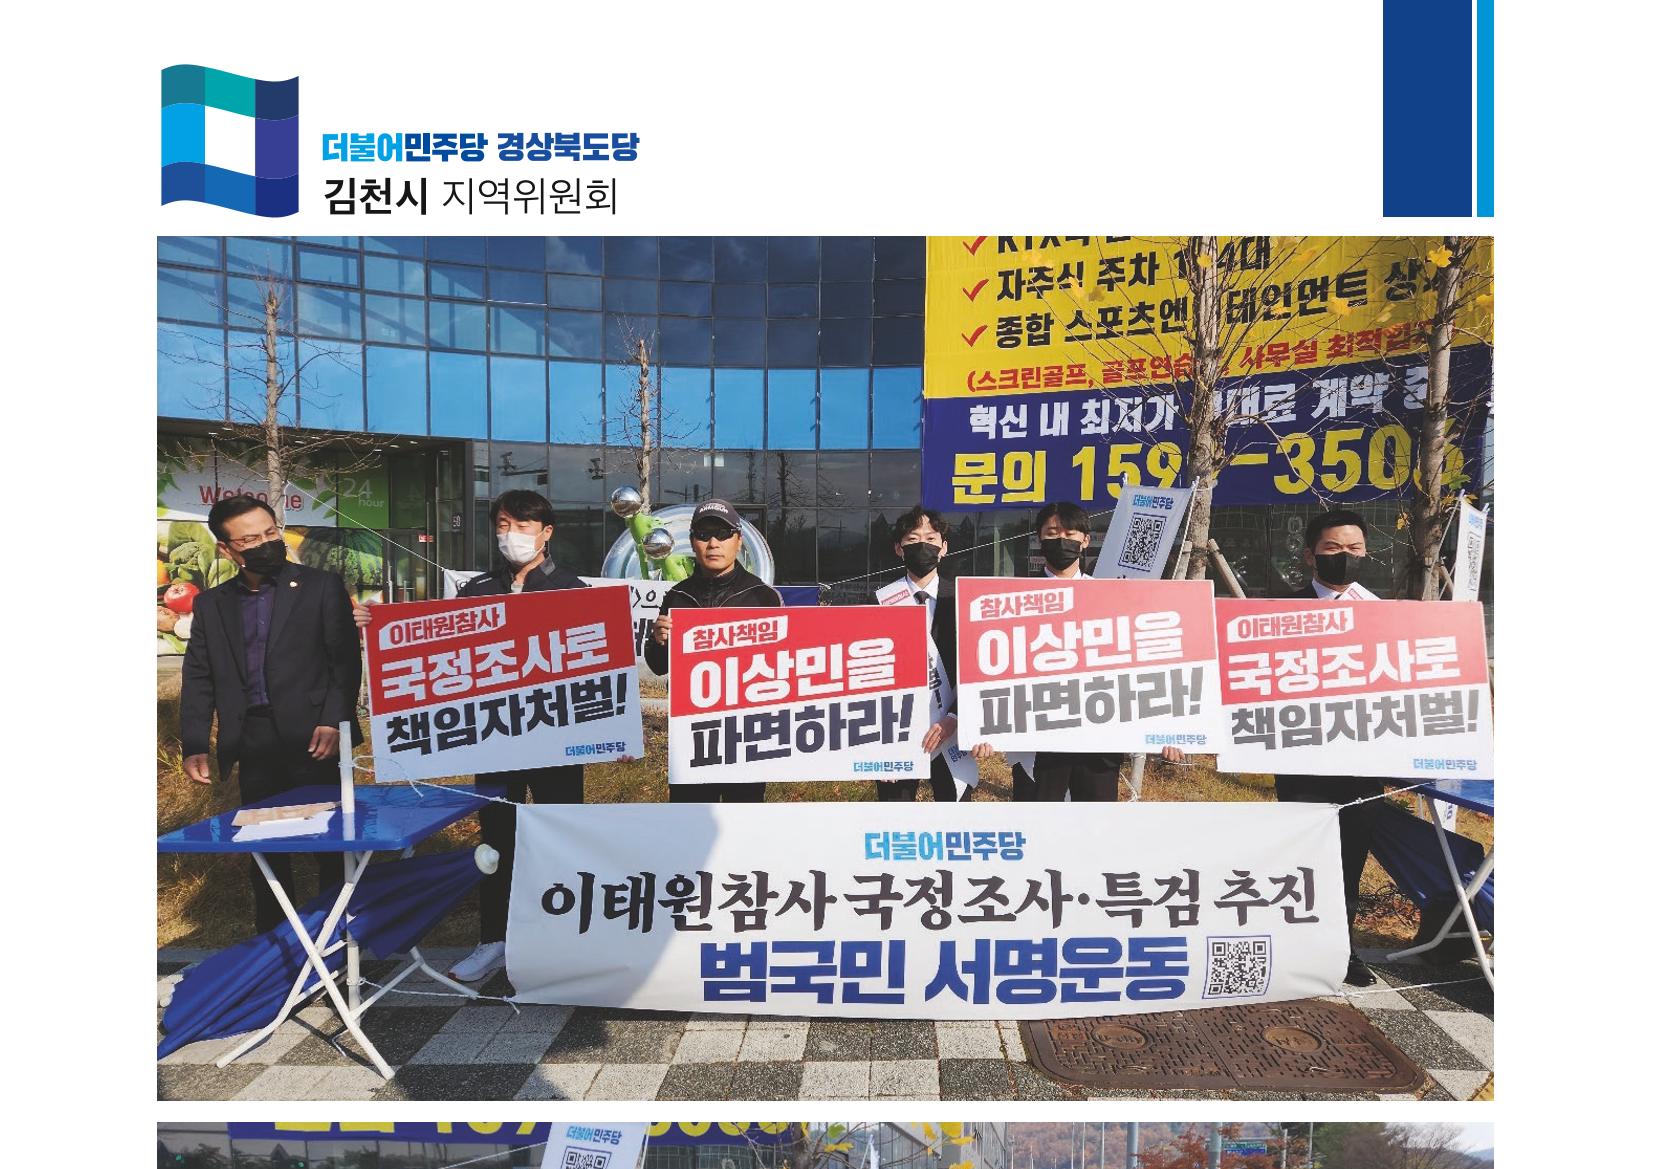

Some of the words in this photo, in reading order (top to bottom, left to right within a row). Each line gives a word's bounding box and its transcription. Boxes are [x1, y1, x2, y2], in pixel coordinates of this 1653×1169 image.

[997, 261, 1084, 301] 자주식
[1097, 251, 1160, 291] 주차
[996, 312, 1054, 348] 종합
[1065, 269, 1368, 342] 스포츠엔테인먼트
[969, 404, 1028, 439] 혁신
[1040, 402, 1070, 436] 내
[1080, 395, 1180, 436] 최저가
[1311, 371, 1390, 419] 계약
[344, 478, 372, 498] 24
[952, 451, 1047, 505] 문의
[388, 607, 500, 646] 이태원참사
[980, 592, 1065, 619] 참사책임
[1238, 611, 1348, 640] 이태원참사
[381, 621, 610, 703] 국정조사로
[693, 622, 778, 648] 참사책임
[977, 611, 1184, 676] 이상민을
[690, 637, 896, 710] 이상민을
[1228, 636, 1461, 696] 국정조사로
[386, 672, 628, 754] 책임자처벌!
[979, 667, 1204, 736] 파면하라!
[1231, 689, 1479, 749] 책임자처벌!
[565, 741, 626, 758] 더불어민주당
[690, 693, 914, 768] 파면하라!
[1145, 733, 1207, 746] 더불어민주당
[853, 760, 914, 773] 더불어민주당
[1413, 758, 1478, 771] 더불어민주당
[864, 832, 1027, 863] 더불어민주당
[541, 869, 838, 935] 이태원참사
[1214, 867, 1321, 927] 추진
[700, 939, 907, 1006] 범국민
[924, 936, 1191, 1004] 서명운동
[566, 1126, 622, 1144] 더불어민주당
